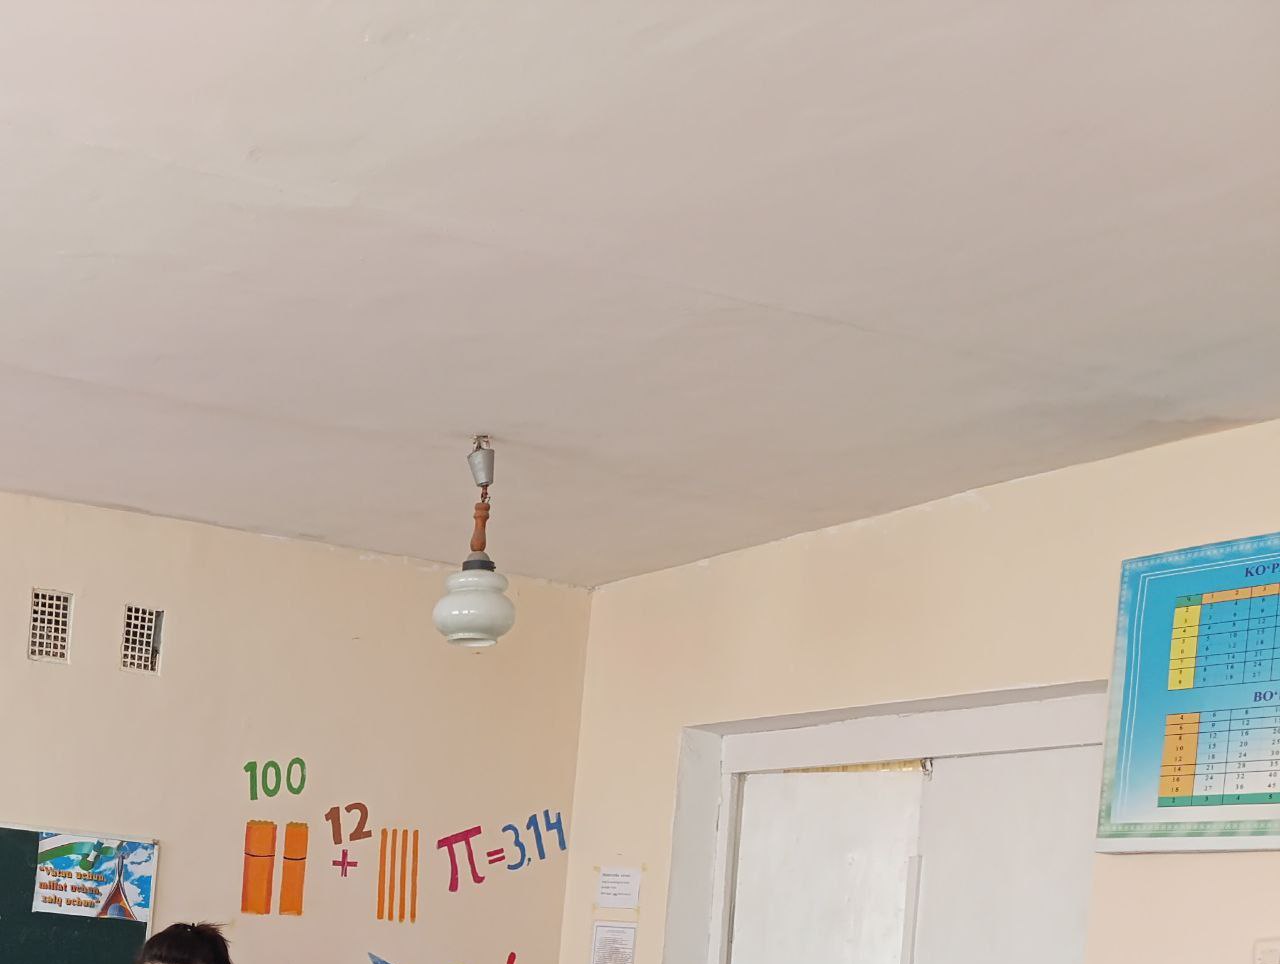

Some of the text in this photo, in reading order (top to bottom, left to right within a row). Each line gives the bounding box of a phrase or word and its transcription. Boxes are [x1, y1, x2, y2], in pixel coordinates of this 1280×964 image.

[1244, 562, 1280, 578] KO'P
[244, 757, 307, 801] 100
[324, 802, 373, 845] 12
